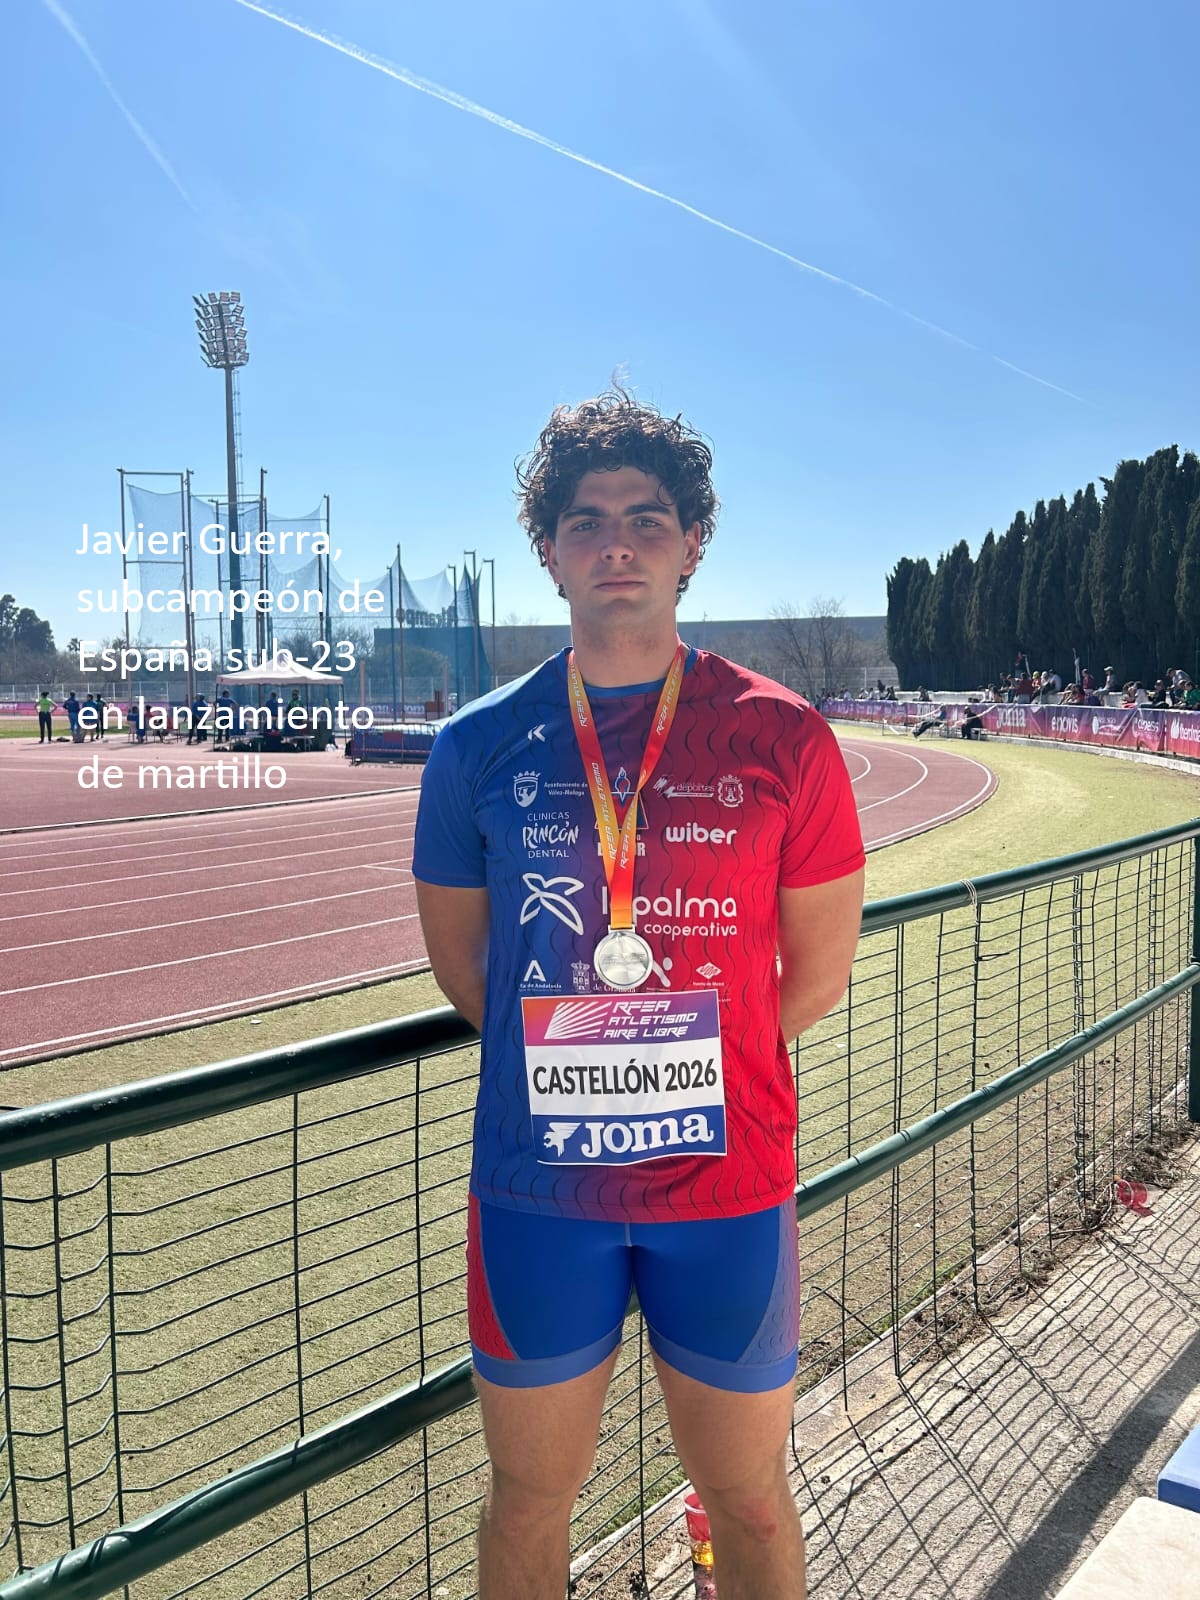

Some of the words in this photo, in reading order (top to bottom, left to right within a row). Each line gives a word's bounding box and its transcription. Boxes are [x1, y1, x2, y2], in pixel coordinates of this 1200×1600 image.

[665, 822, 738, 845] wiber
[527, 849, 570, 859] DENTAL
[632, 887, 737, 927] palma
[643, 921, 738, 941] cooperativa
[612, 1000, 671, 1015] RFEA
[608, 1012, 698, 1026] ATLETISMO
[603, 1028, 639, 1040] AIRE
[642, 1025, 689, 1038] LIBRE
[532, 1058, 660, 1095] CASTELLÓN
[664, 1058, 718, 1092] 2026
